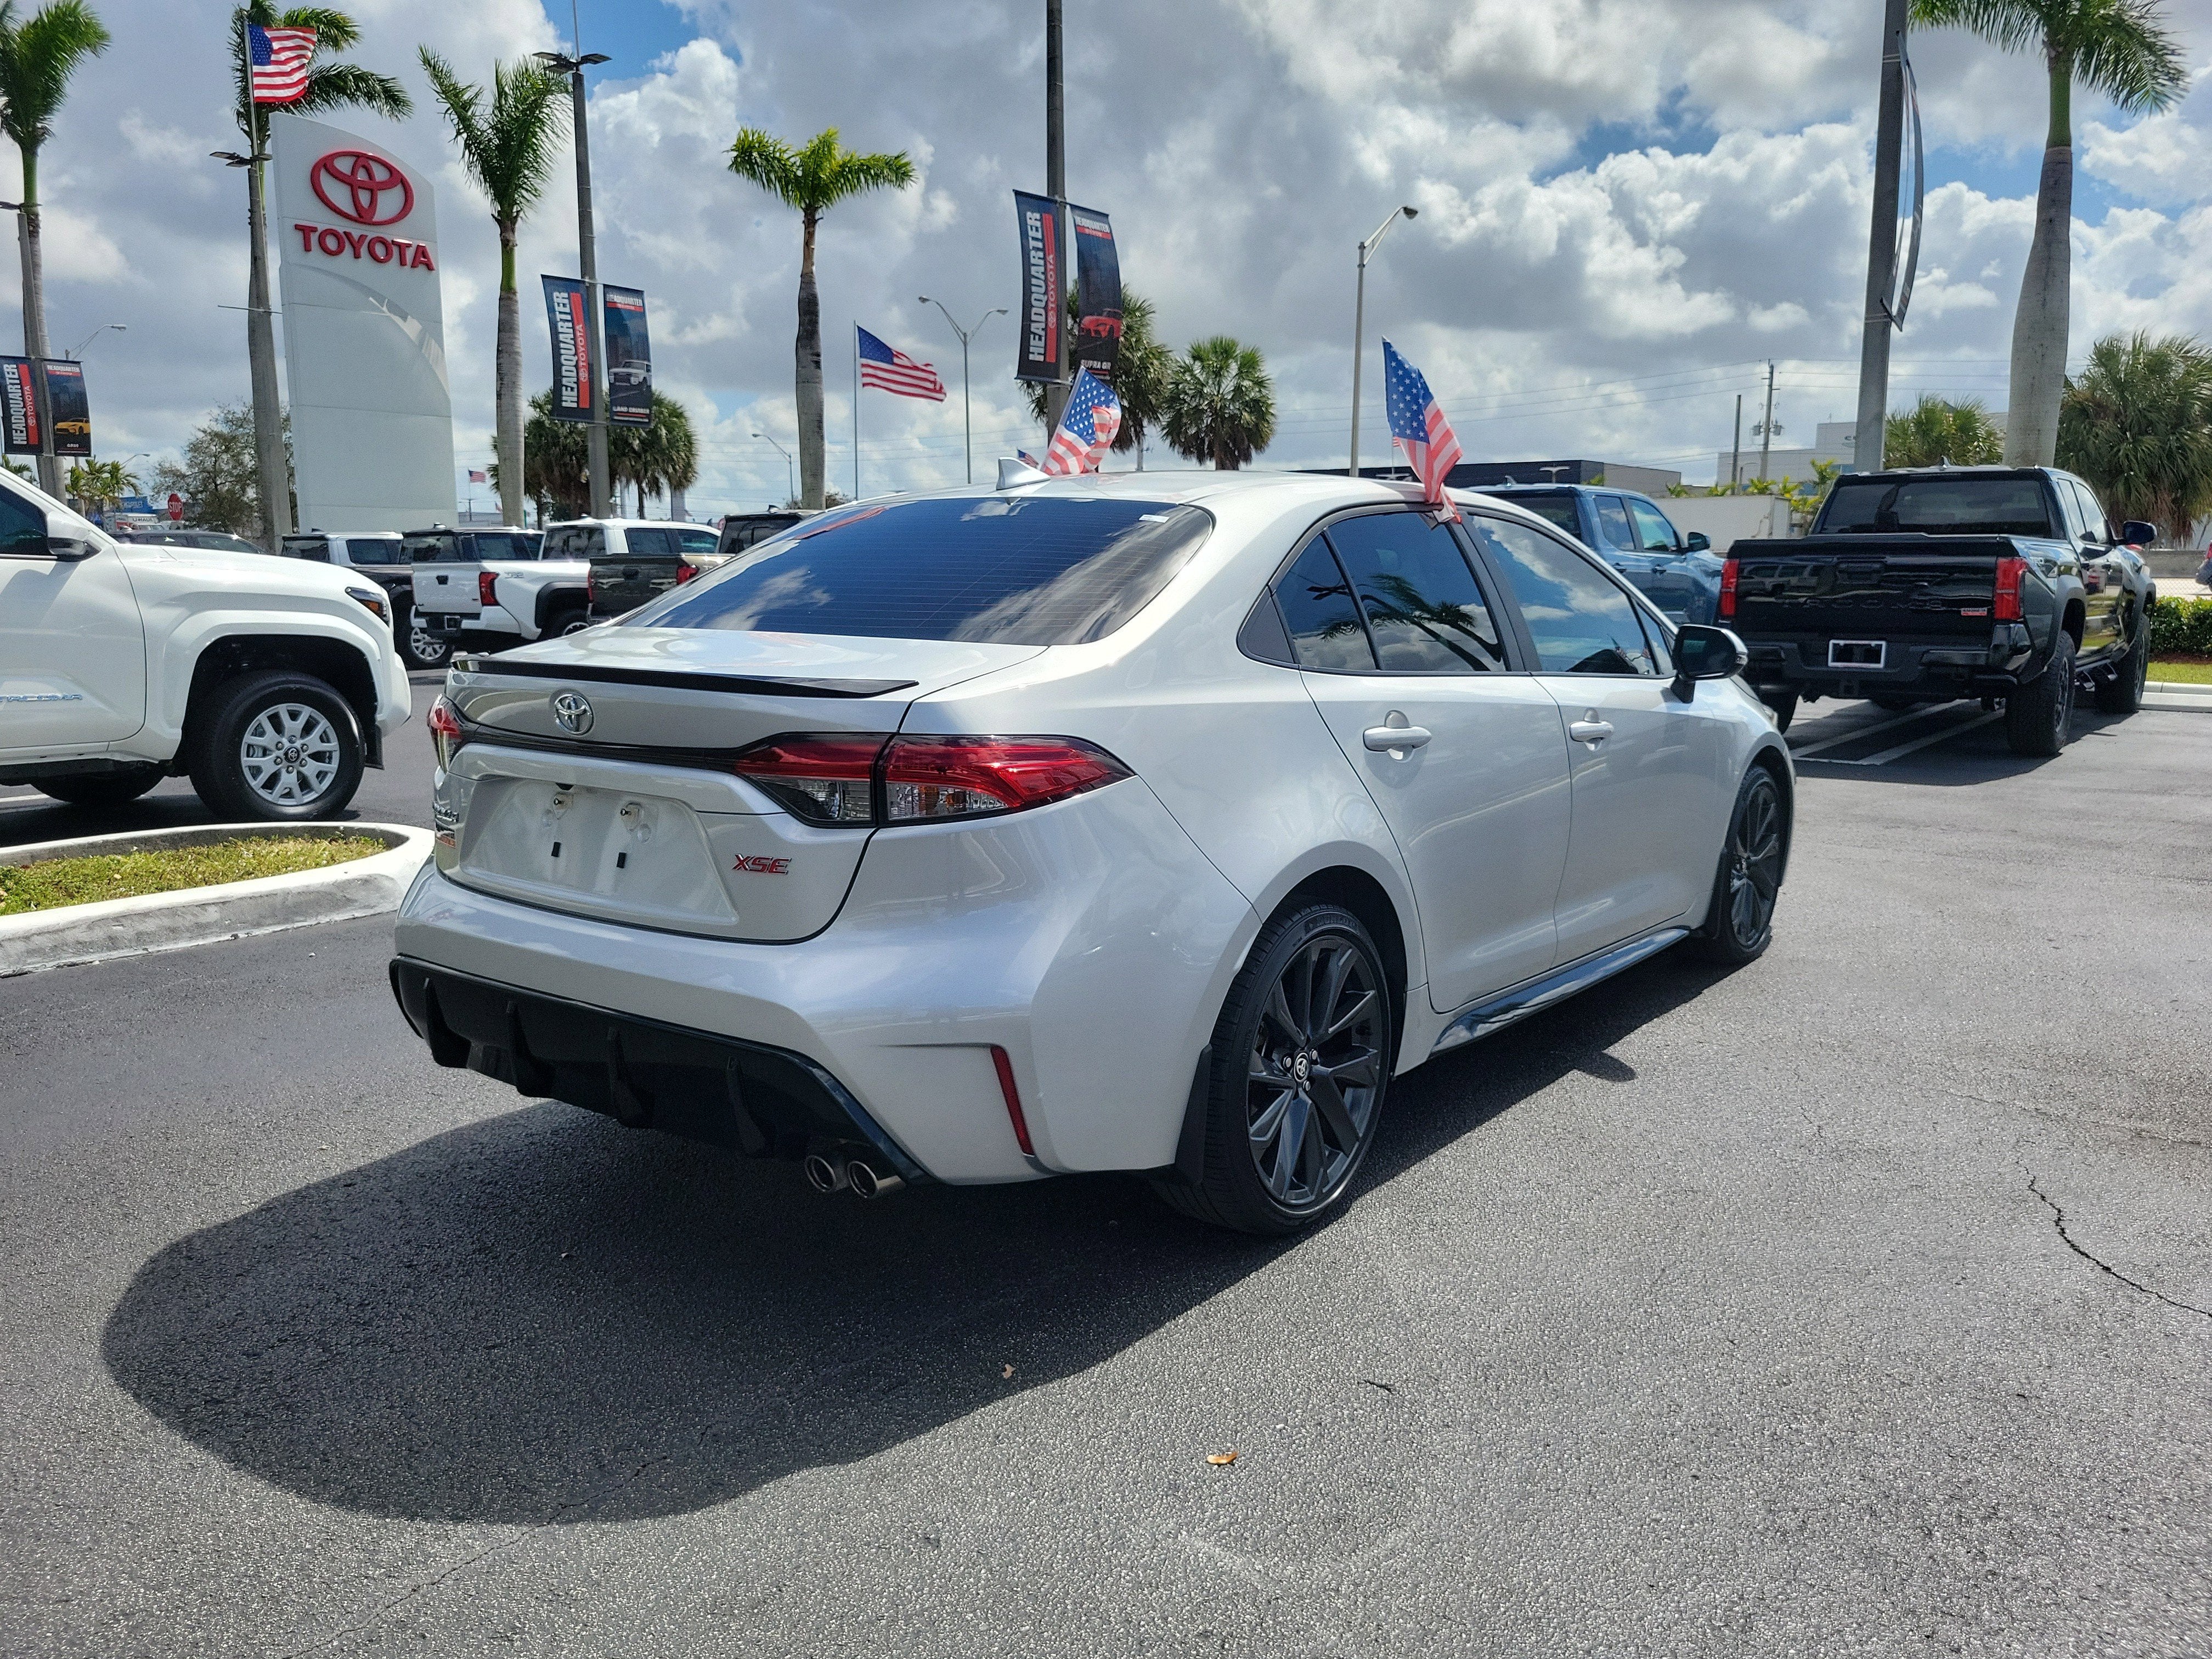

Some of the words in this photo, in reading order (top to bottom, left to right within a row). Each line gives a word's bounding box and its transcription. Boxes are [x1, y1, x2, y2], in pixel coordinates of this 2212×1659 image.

[295, 224, 436, 271] TOYOTA
[1026, 211, 1047, 362] HEADQUARTER
[1047, 255, 1056, 309] TOYOTA
[554, 292, 578, 408] HEADQUARTER
[577, 325, 586, 366] TOYOTA
[3, 364, 27, 444] HEADQUARTER
[24, 386, 36, 416] TOYOTA
[169, 501, 182, 512] STOP
[732, 853, 792, 875] XSE
